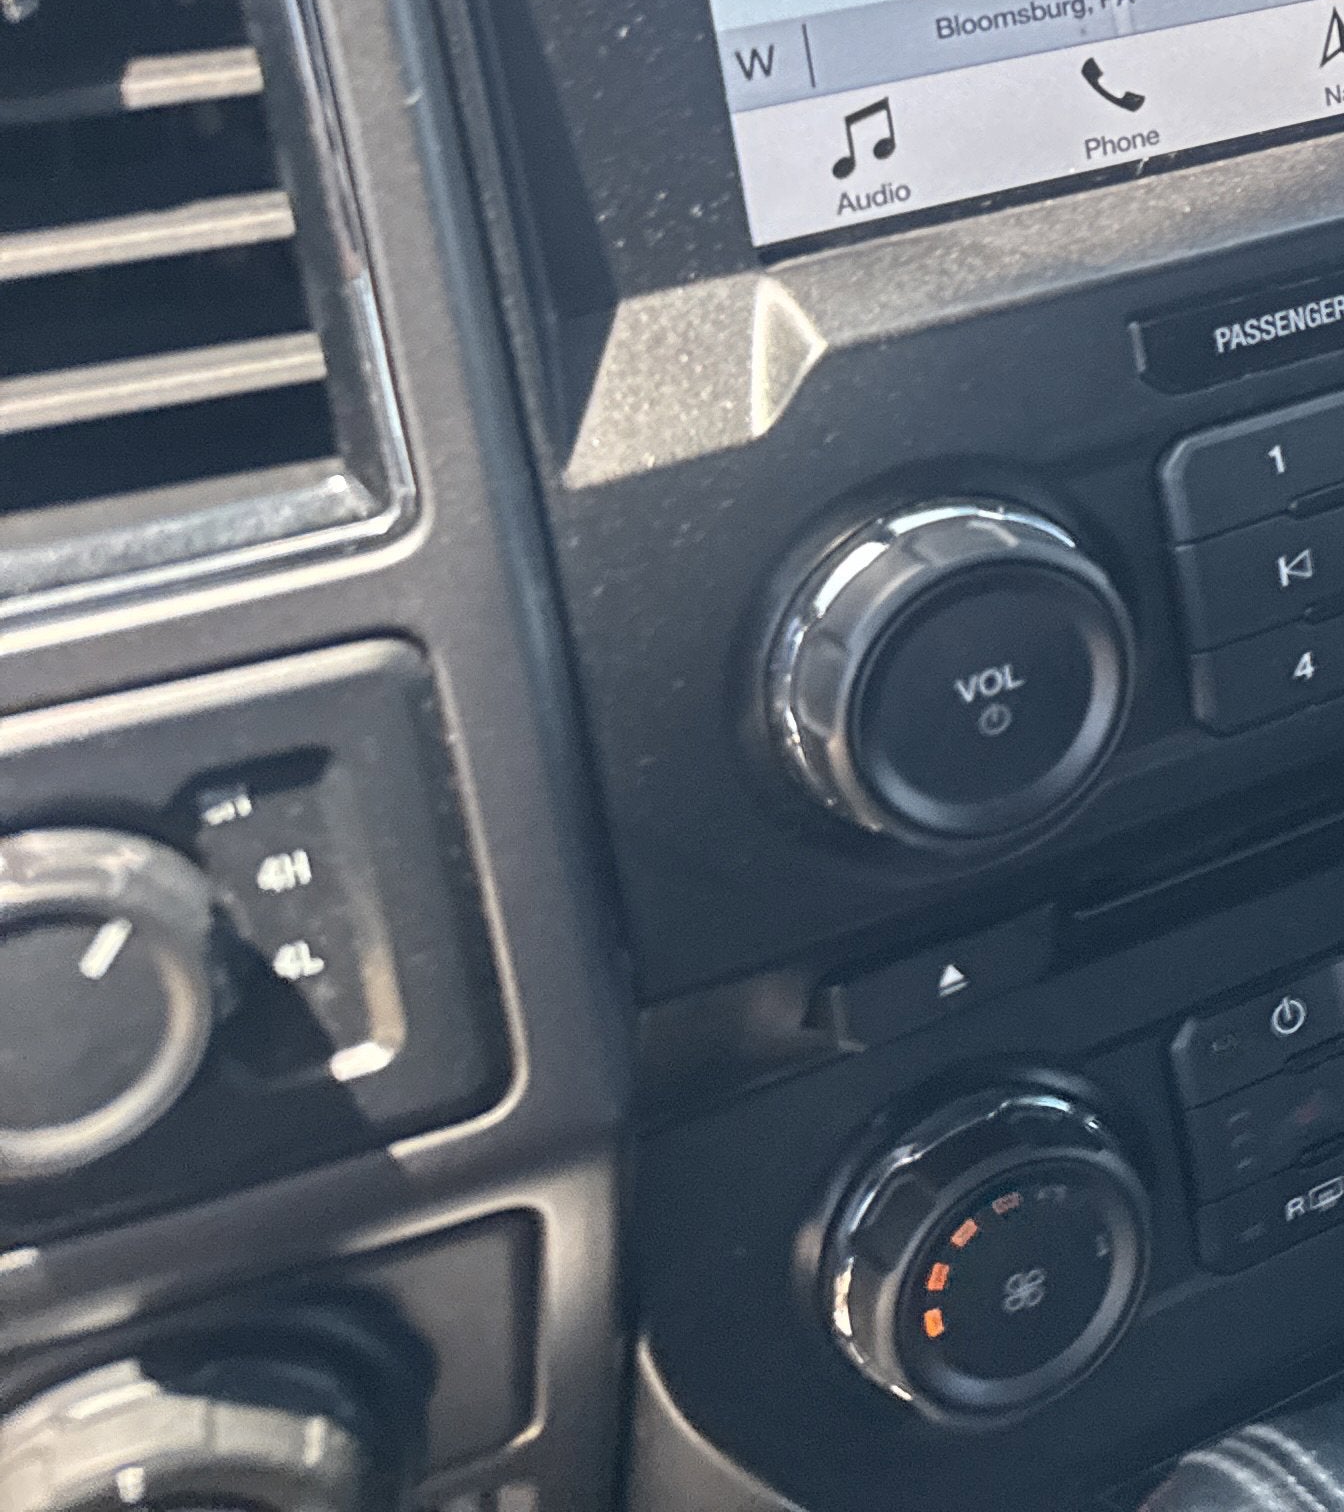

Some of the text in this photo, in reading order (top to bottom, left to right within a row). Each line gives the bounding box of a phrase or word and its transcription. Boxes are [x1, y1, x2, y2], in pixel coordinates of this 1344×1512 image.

[734, 44, 775, 81] W
[1084, 129, 1160, 161] Phone
[837, 181, 911, 216] Audio
[1268, 445, 1285, 473] 1
[1294, 652, 1315, 678] 4
[954, 664, 1025, 703] VOL
[1286, 1196, 1305, 1221] R
